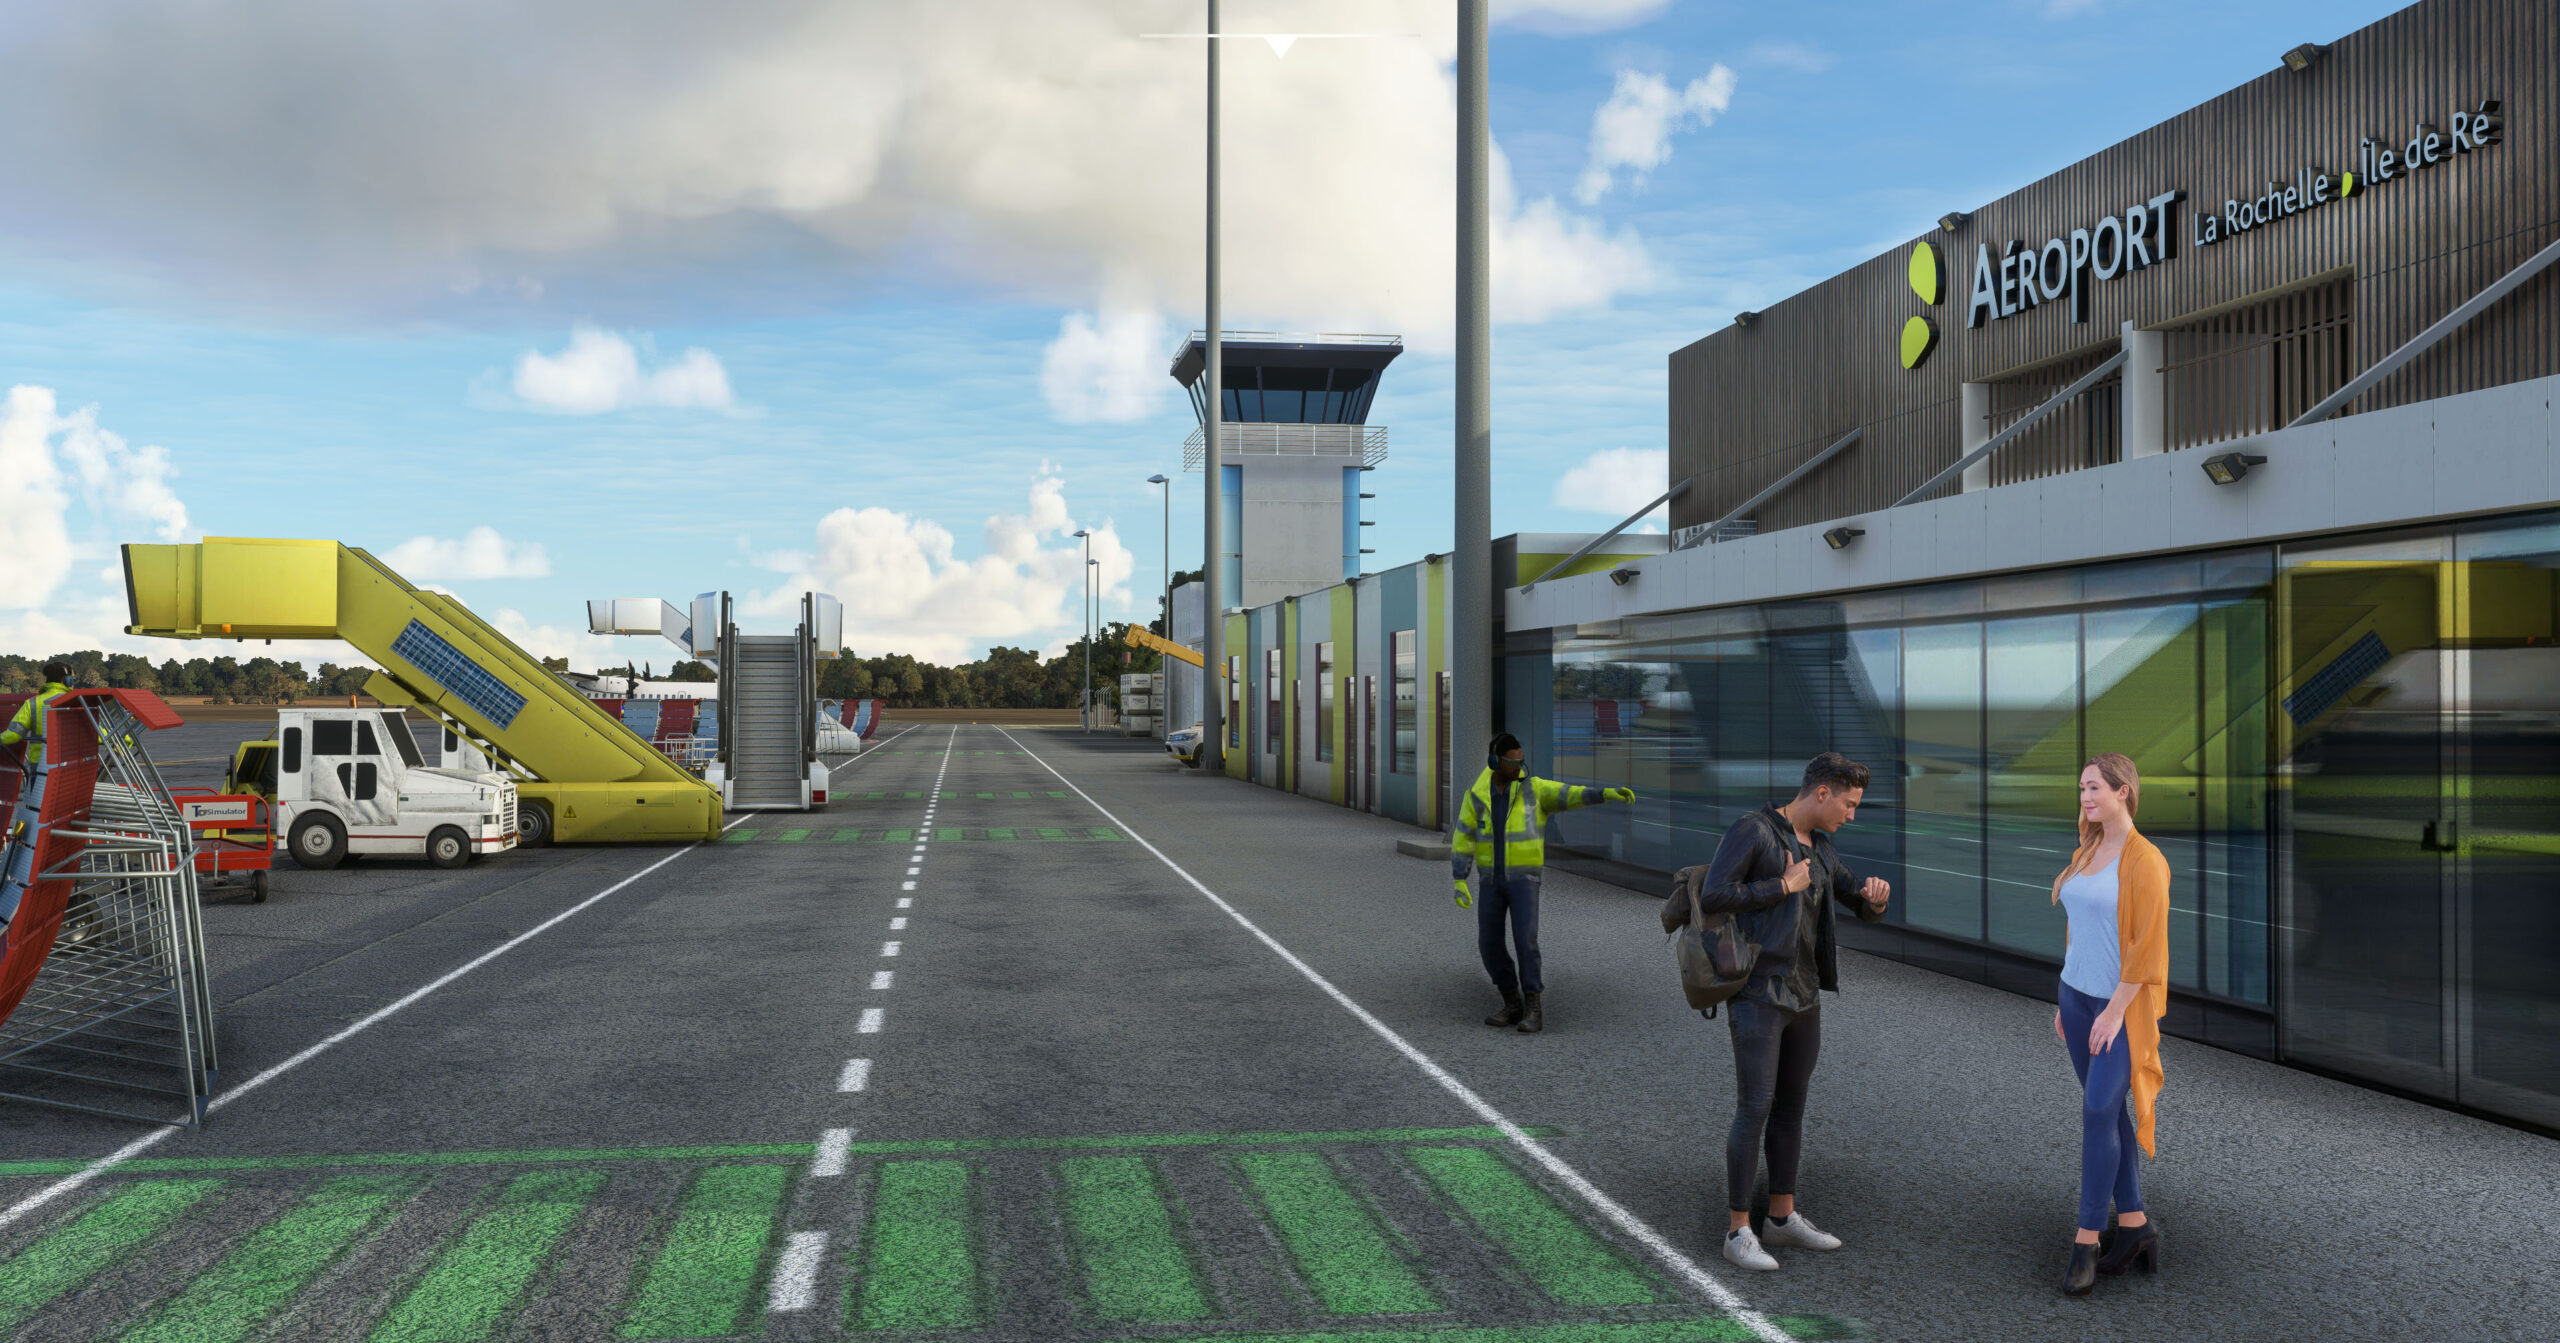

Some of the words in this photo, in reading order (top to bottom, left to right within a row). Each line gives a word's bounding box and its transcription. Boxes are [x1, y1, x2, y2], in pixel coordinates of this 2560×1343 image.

[2195, 212, 2216, 247] La
[2225, 166, 2328, 236] Rochelle
[2361, 137, 2394, 186] Île
[2405, 123, 2439, 170] de
[2452, 100, 2491, 153] Ré
[1967, 189, 2176, 330] AÉROPORT
